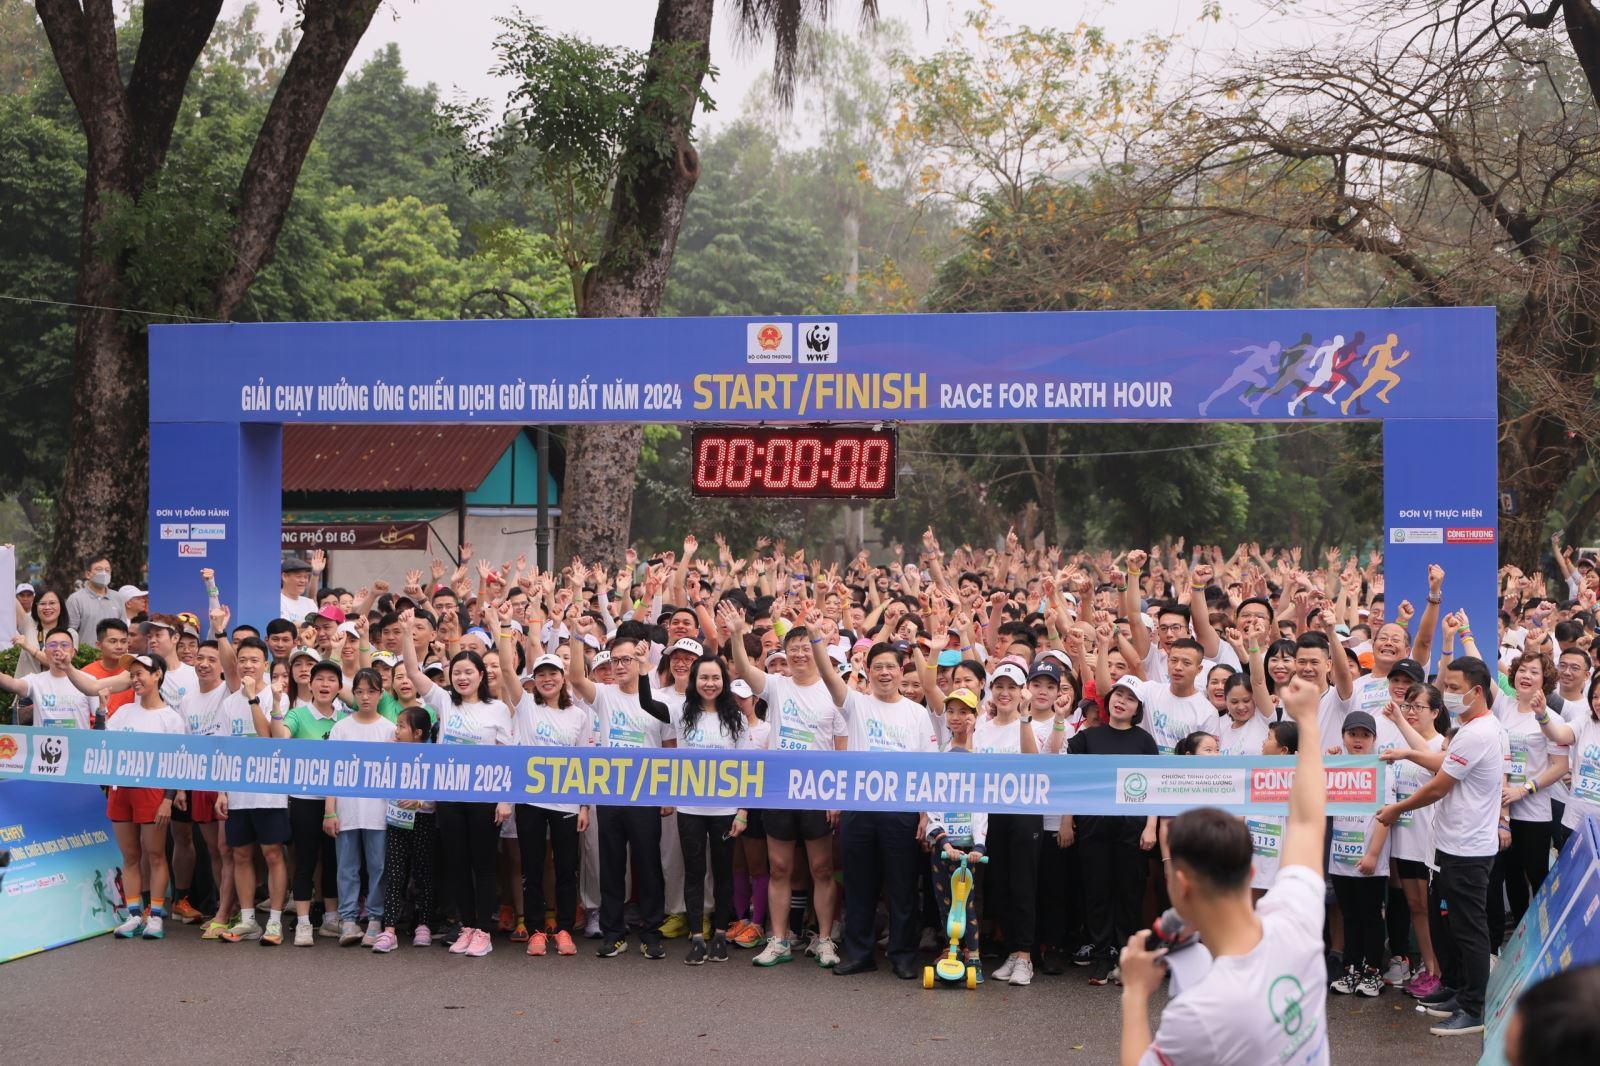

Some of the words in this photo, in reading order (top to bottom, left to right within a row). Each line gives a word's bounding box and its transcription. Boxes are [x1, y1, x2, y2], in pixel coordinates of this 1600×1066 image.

[806, 353, 830, 361] WWF
[241, 377, 271, 411] GIẢI
[275, 385, 314, 417] CHẠY
[317, 377, 369, 411] HƯỞNG
[373, 379, 404, 411] ỨNG
[408, 376, 454, 411] CHIẾN
[458, 384, 495, 416] DỊCH
[499, 377, 526, 411] GIỜ
[529, 378, 564, 410] TRÁI
[568, 374, 598, 410] ĐẤT
[602, 378, 639, 410] NĂM
[643, 384, 682, 410] 2024
[693, 372, 927, 416] START/FINISH
[940, 383, 992, 409] RACE
[999, 382, 1038, 409] FOR
[1044, 382, 1106, 408] EARTH
[1113, 381, 1173, 408] HOUR
[697, 438, 889, 489] 00:00:00
[156, 508, 173, 517] ĐƠN
[175, 509, 182, 518] VỊ
[184, 506, 206, 517] ĐỒNG
[208, 508, 230, 517] HÀNH
[1399, 509, 1420, 518] ĐƠN
[1423, 509, 1432, 520] VỊ
[1435, 508, 1459, 519] THỰC
[1461, 508, 1483, 519] HIỆN
[300, 528, 325, 543] PHỐ
[325, 533, 338, 543] ĐI
[340, 529, 356, 545] BỘ
[38, 765, 60, 774] WWF
[83, 740, 113, 775] GIẢI
[115, 749, 152, 783] CHẠY
[156, 744, 208, 781] HƯỞNG
[211, 749, 242, 783] ỨNG
[245, 748, 291, 785] CHIẾN
[293, 758, 330, 791] DỊCH
[333, 754, 361, 788] GIỜ
[364, 756, 397, 790] TRÁI
[400, 752, 431, 790] ĐẤT
[433, 758, 471, 791] NĂM
[473, 764, 512, 792] 2024
[525, 756, 765, 801] START/FINISH
[788, 768, 848, 801] RACE
[854, 770, 899, 802] FOR
[905, 771, 976, 803] EARTH
[983, 772, 1051, 805] HOUR
[387, 806, 413, 821] 16.596
[1334, 843, 1363, 855] 16.592
